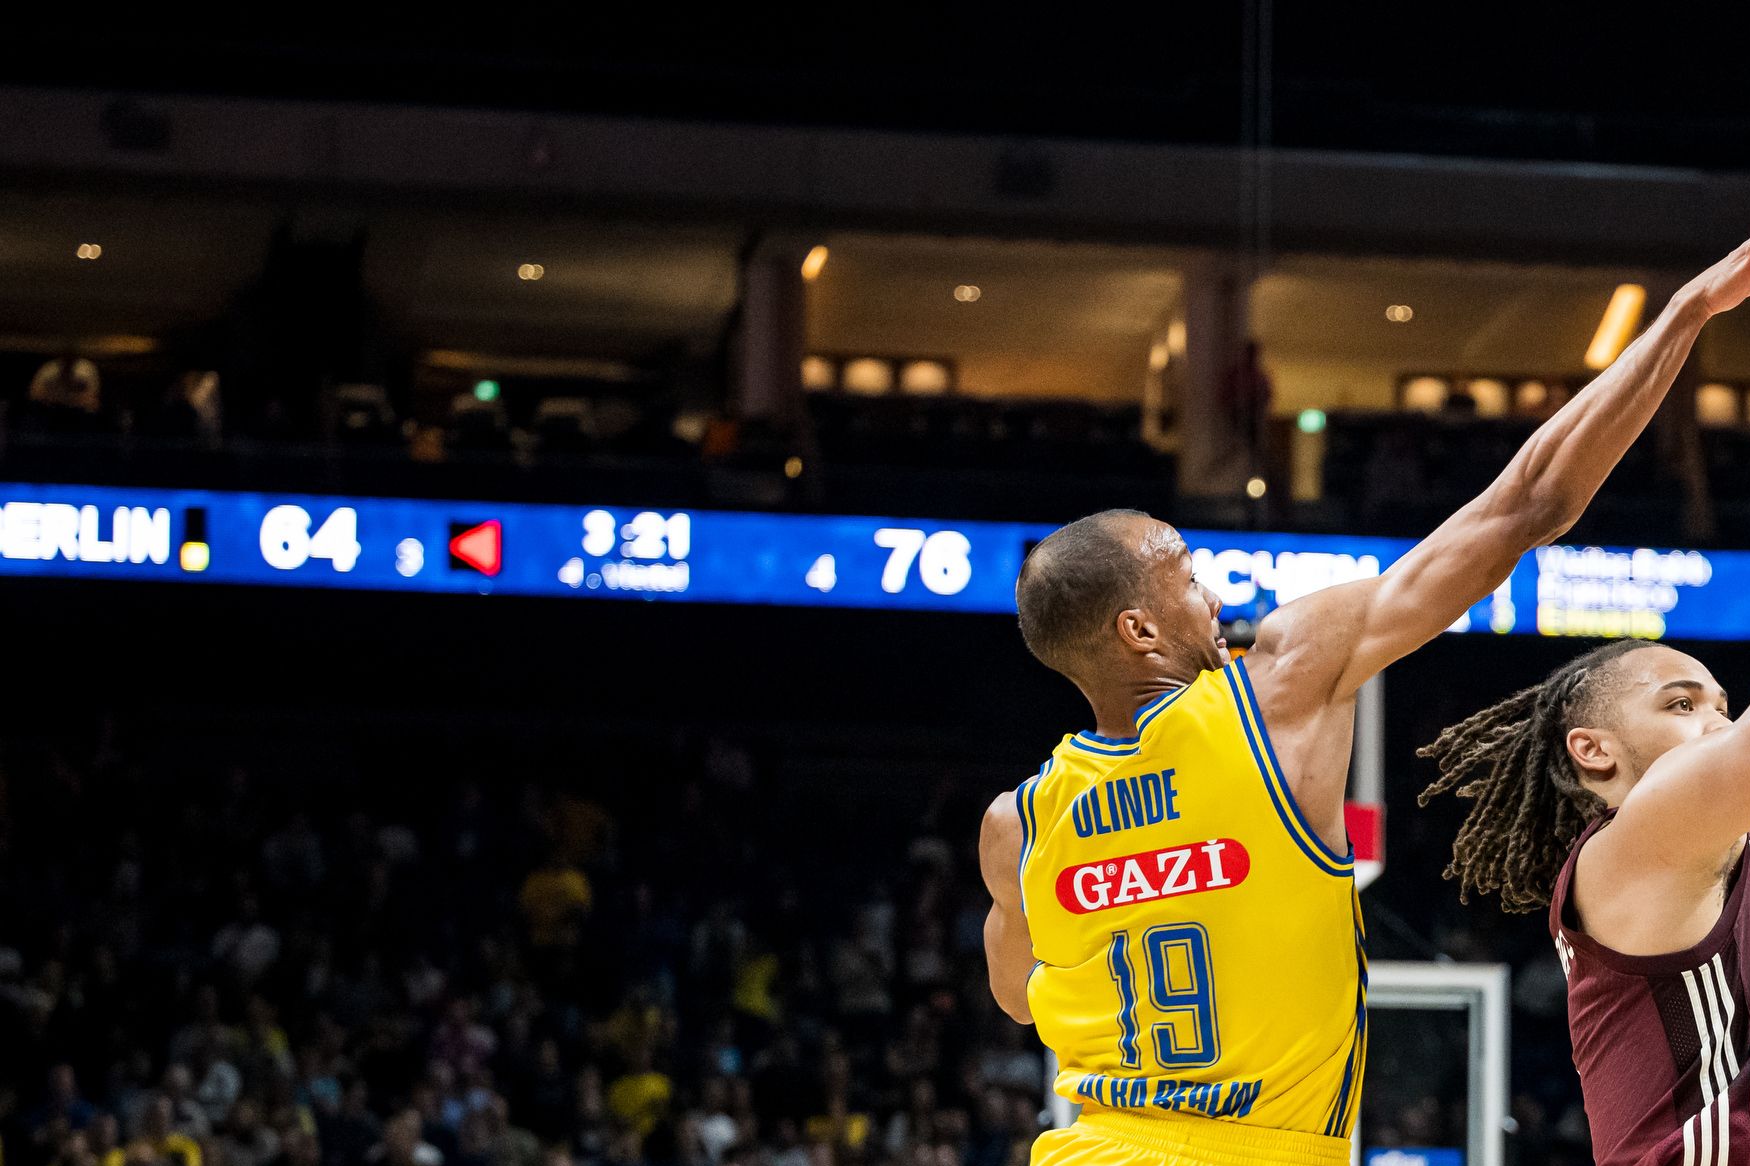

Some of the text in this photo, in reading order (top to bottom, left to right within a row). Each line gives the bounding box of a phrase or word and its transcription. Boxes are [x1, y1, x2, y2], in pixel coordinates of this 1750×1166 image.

[0, 501, 171, 564] ERLIN
[259, 504, 362, 572] 64
[395, 537, 424, 577] 3
[581, 509, 691, 560] 3:21
[873, 527, 972, 596] 76
[805, 553, 837, 593] 4
[1107, 921, 1222, 1071] 19
